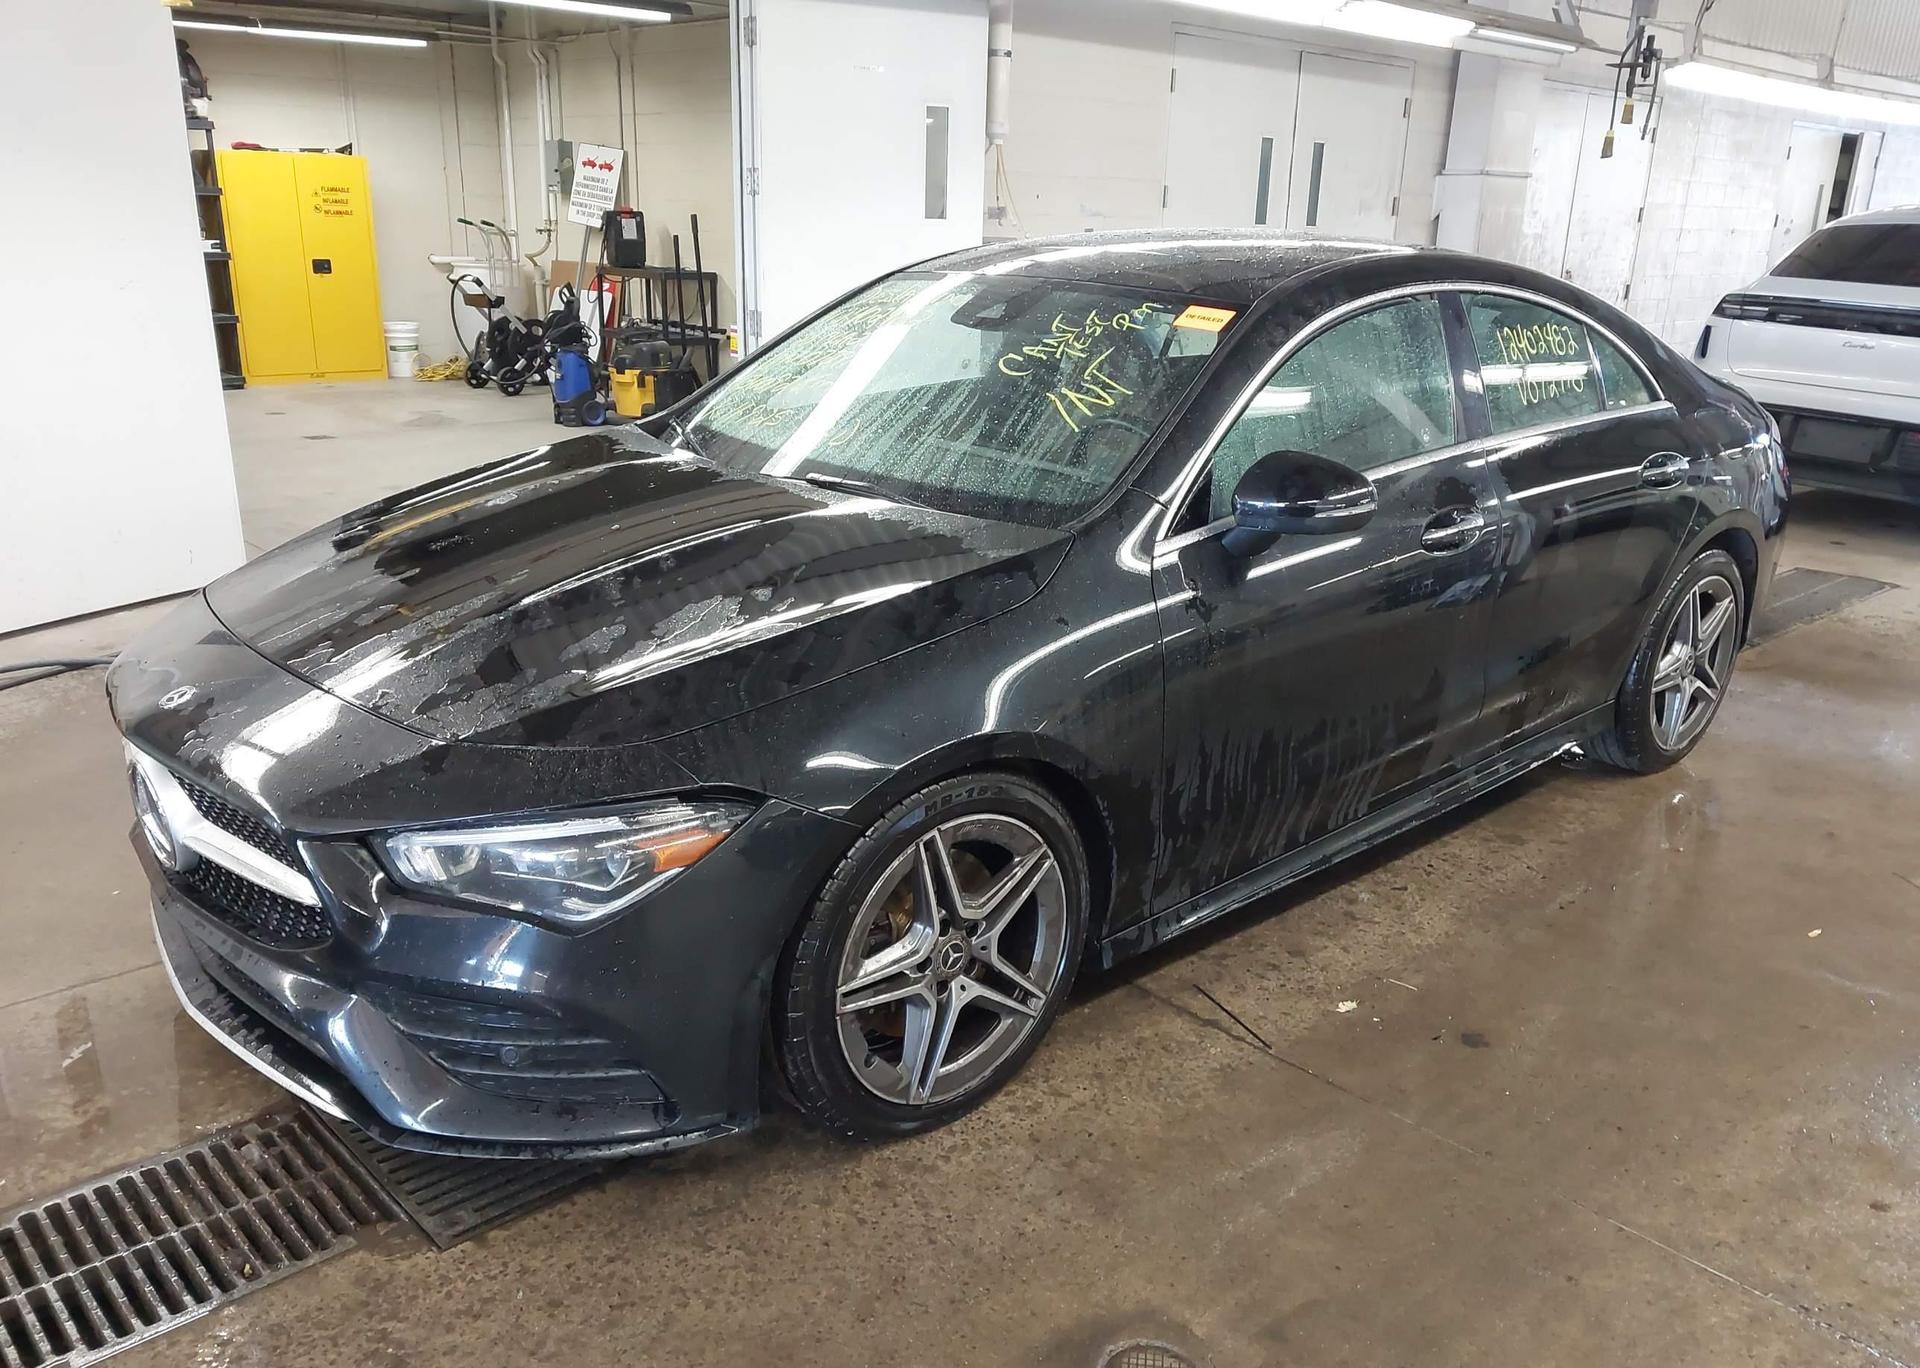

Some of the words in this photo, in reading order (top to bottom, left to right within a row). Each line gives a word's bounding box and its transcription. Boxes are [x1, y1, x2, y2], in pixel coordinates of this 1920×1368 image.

[998, 313, 1082, 376] CANT
[1185, 313, 1224, 324] DETAILED
[1496, 322, 1580, 365] 12402482
[1046, 346, 1134, 432] INT
